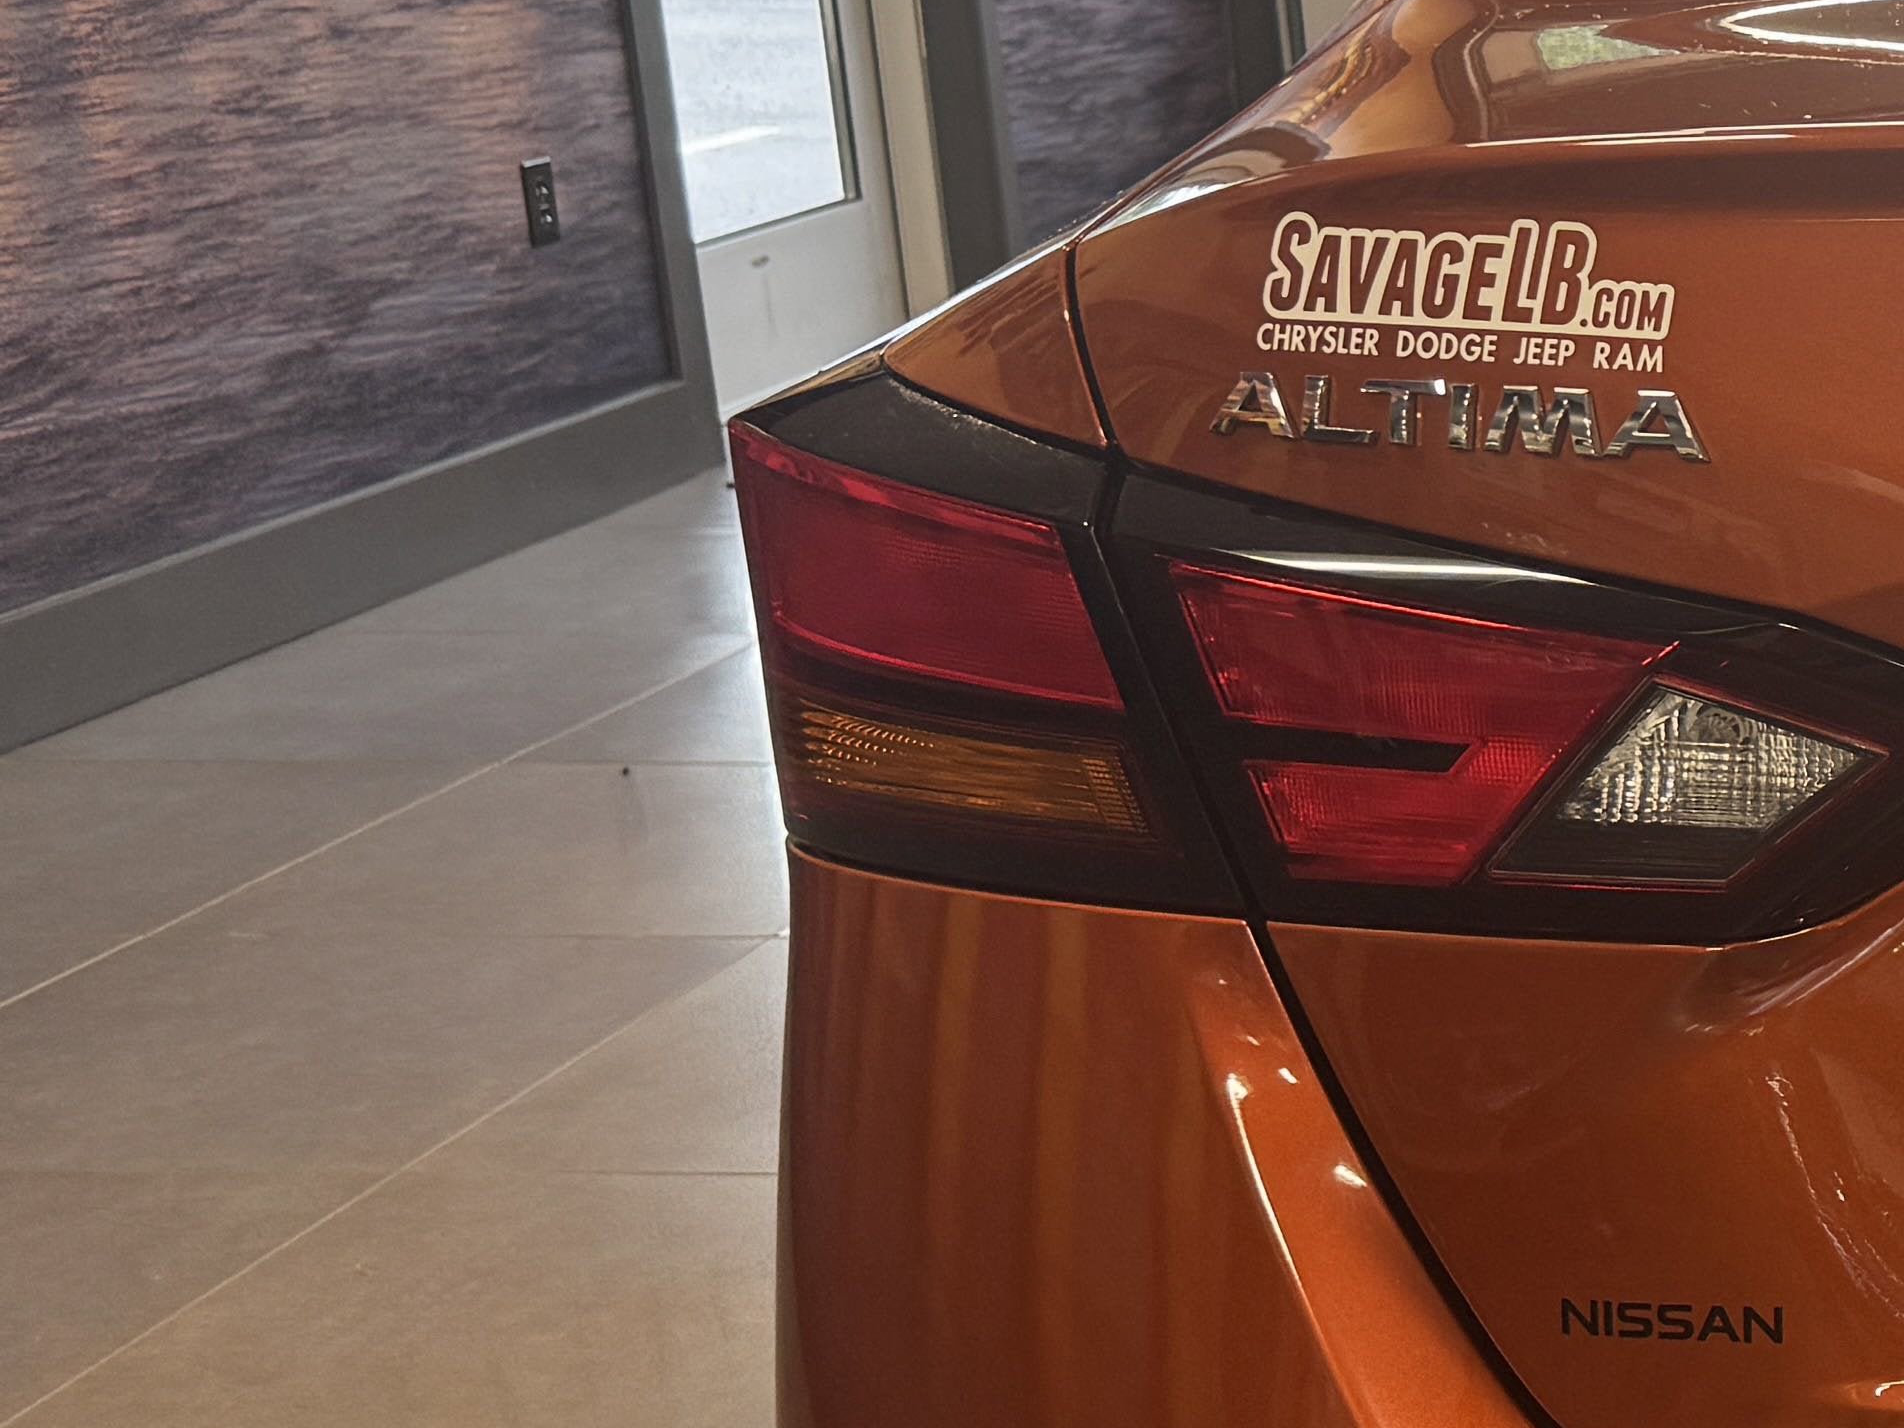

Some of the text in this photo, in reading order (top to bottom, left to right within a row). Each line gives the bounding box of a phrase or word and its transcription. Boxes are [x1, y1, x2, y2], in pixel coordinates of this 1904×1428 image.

[1256, 322, 1664, 373] CHRYSLER DODGE JEEP RAM
[1209, 372, 1711, 462] ALTIMA
[1560, 1297, 1784, 1345] NISSAN
